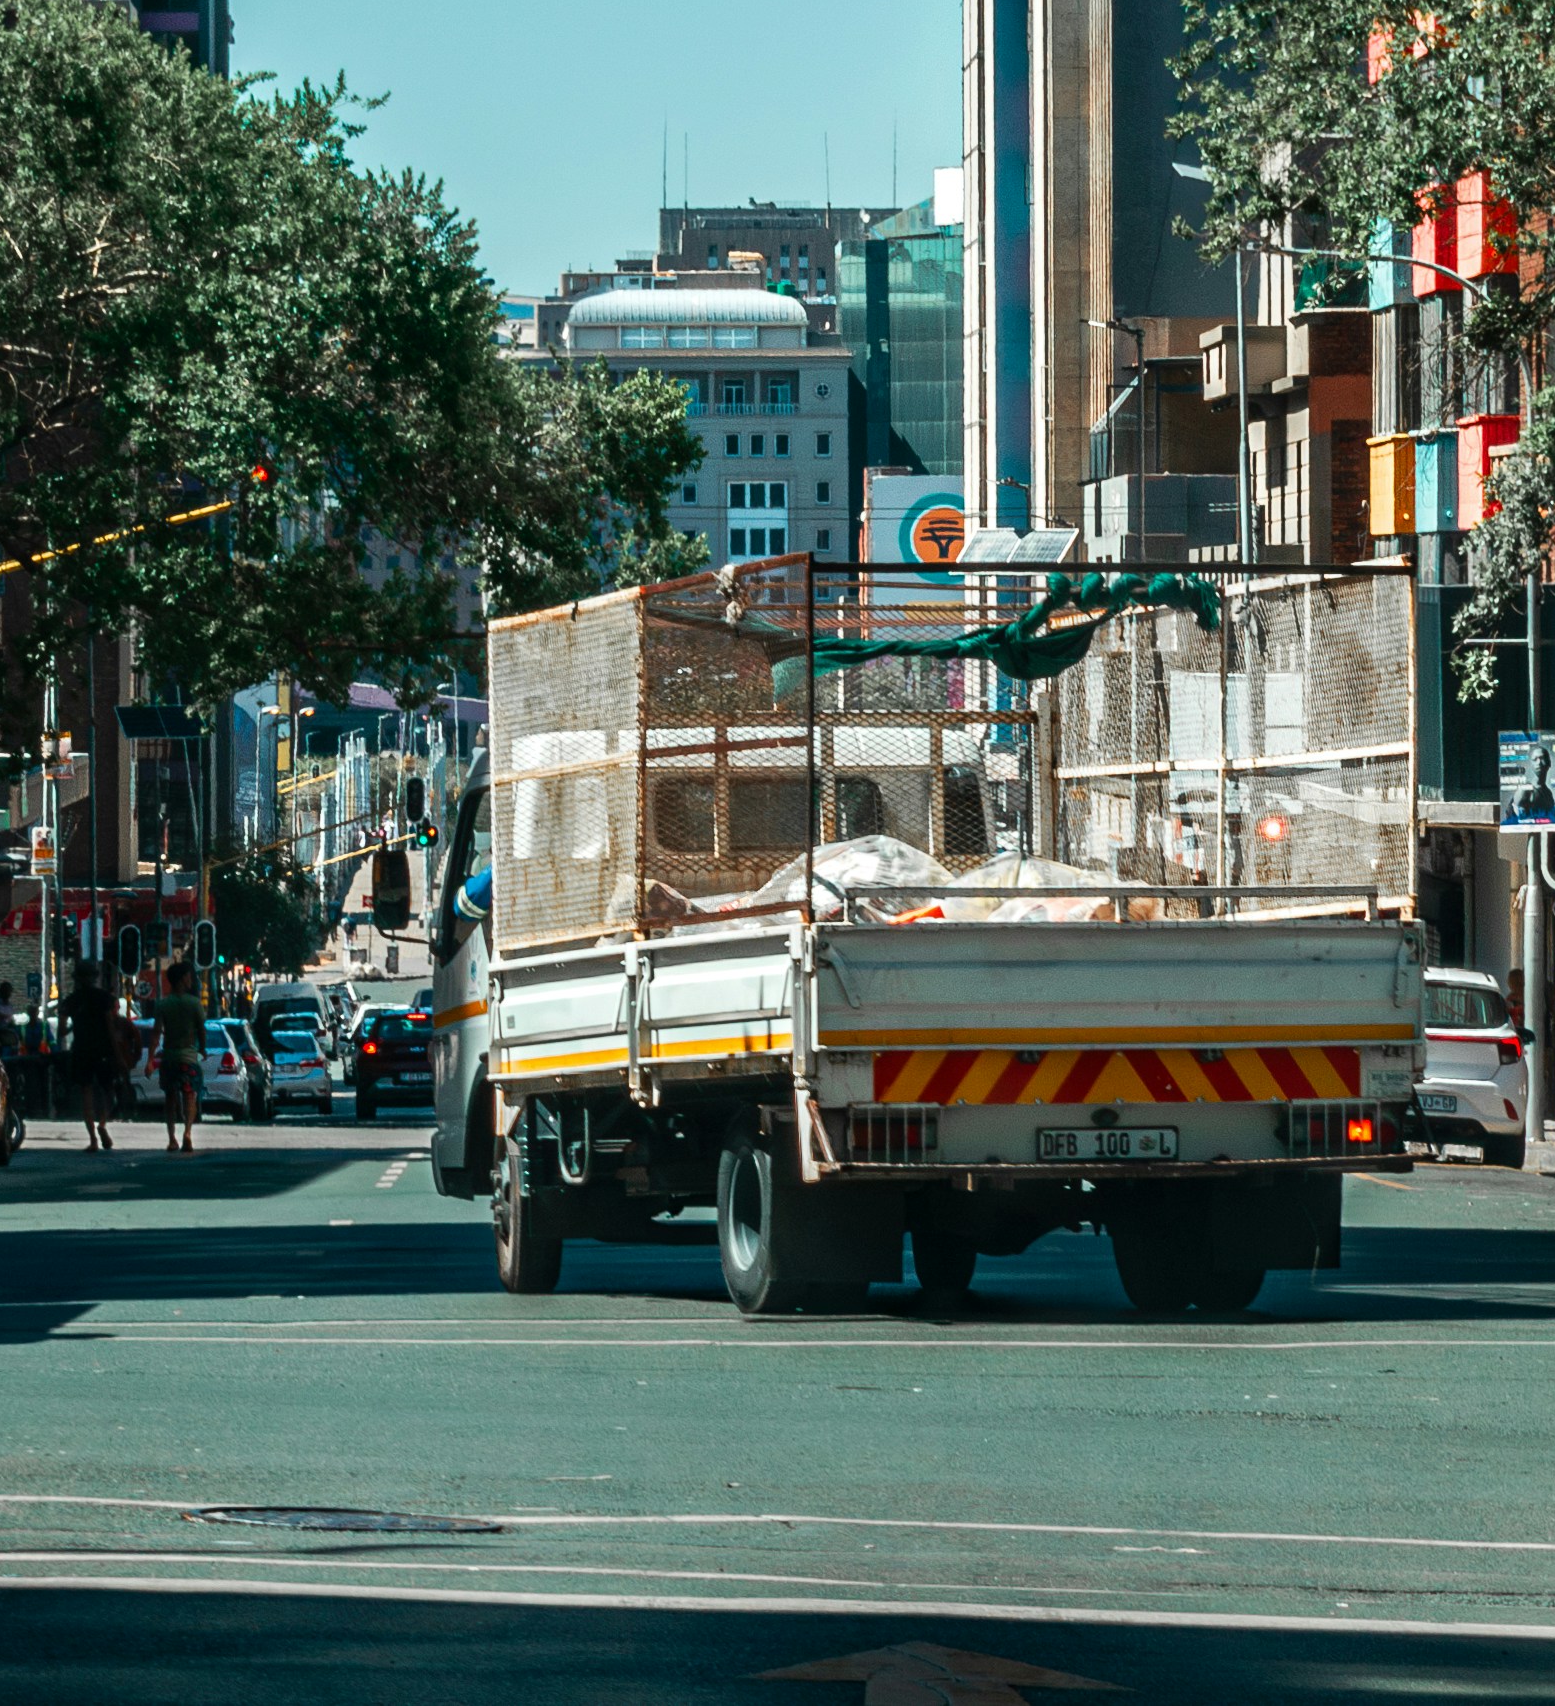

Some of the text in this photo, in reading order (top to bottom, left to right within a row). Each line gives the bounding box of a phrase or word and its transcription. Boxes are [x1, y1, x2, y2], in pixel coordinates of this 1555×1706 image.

[1044, 1132, 1171, 1156] DFB 100 L
